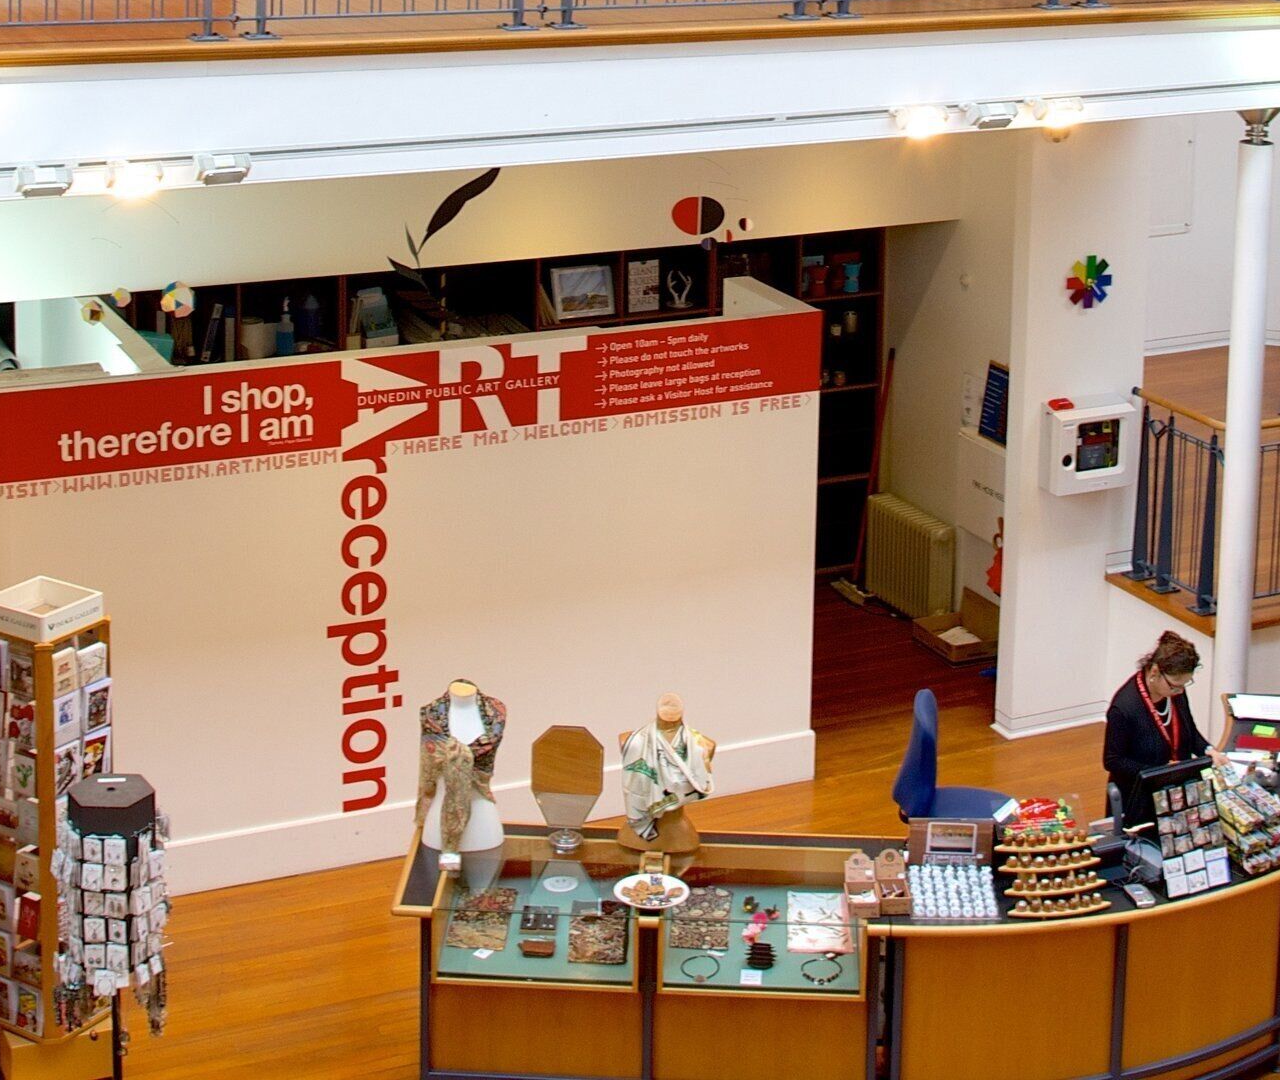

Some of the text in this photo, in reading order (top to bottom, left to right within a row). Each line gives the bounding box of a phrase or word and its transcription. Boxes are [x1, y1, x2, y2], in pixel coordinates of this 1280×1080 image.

[609, 341, 633, 352] Open
[635, 338, 659, 349] 10am
[667, 335, 687, 347] 5pm
[688, 333, 709, 344] daily
[609, 342, 749, 365] Please do not touch the artworks
[609, 359, 716, 379] Photography not allowed
[609, 368, 761, 393] Please leave large bags at reception
[203, 381, 314, 416] I shop,
[357, 375, 561, 407] DUNEDIN PUBLIC ART GALLERY
[609, 379, 774, 407] Please ask a Visitor Host for assistance
[58, 413, 314, 462] therefore I am
[403, 394, 802, 455] HAERE MAI WELCOME ADMISSION IS FREE
[327, 447, 402, 813] reception
